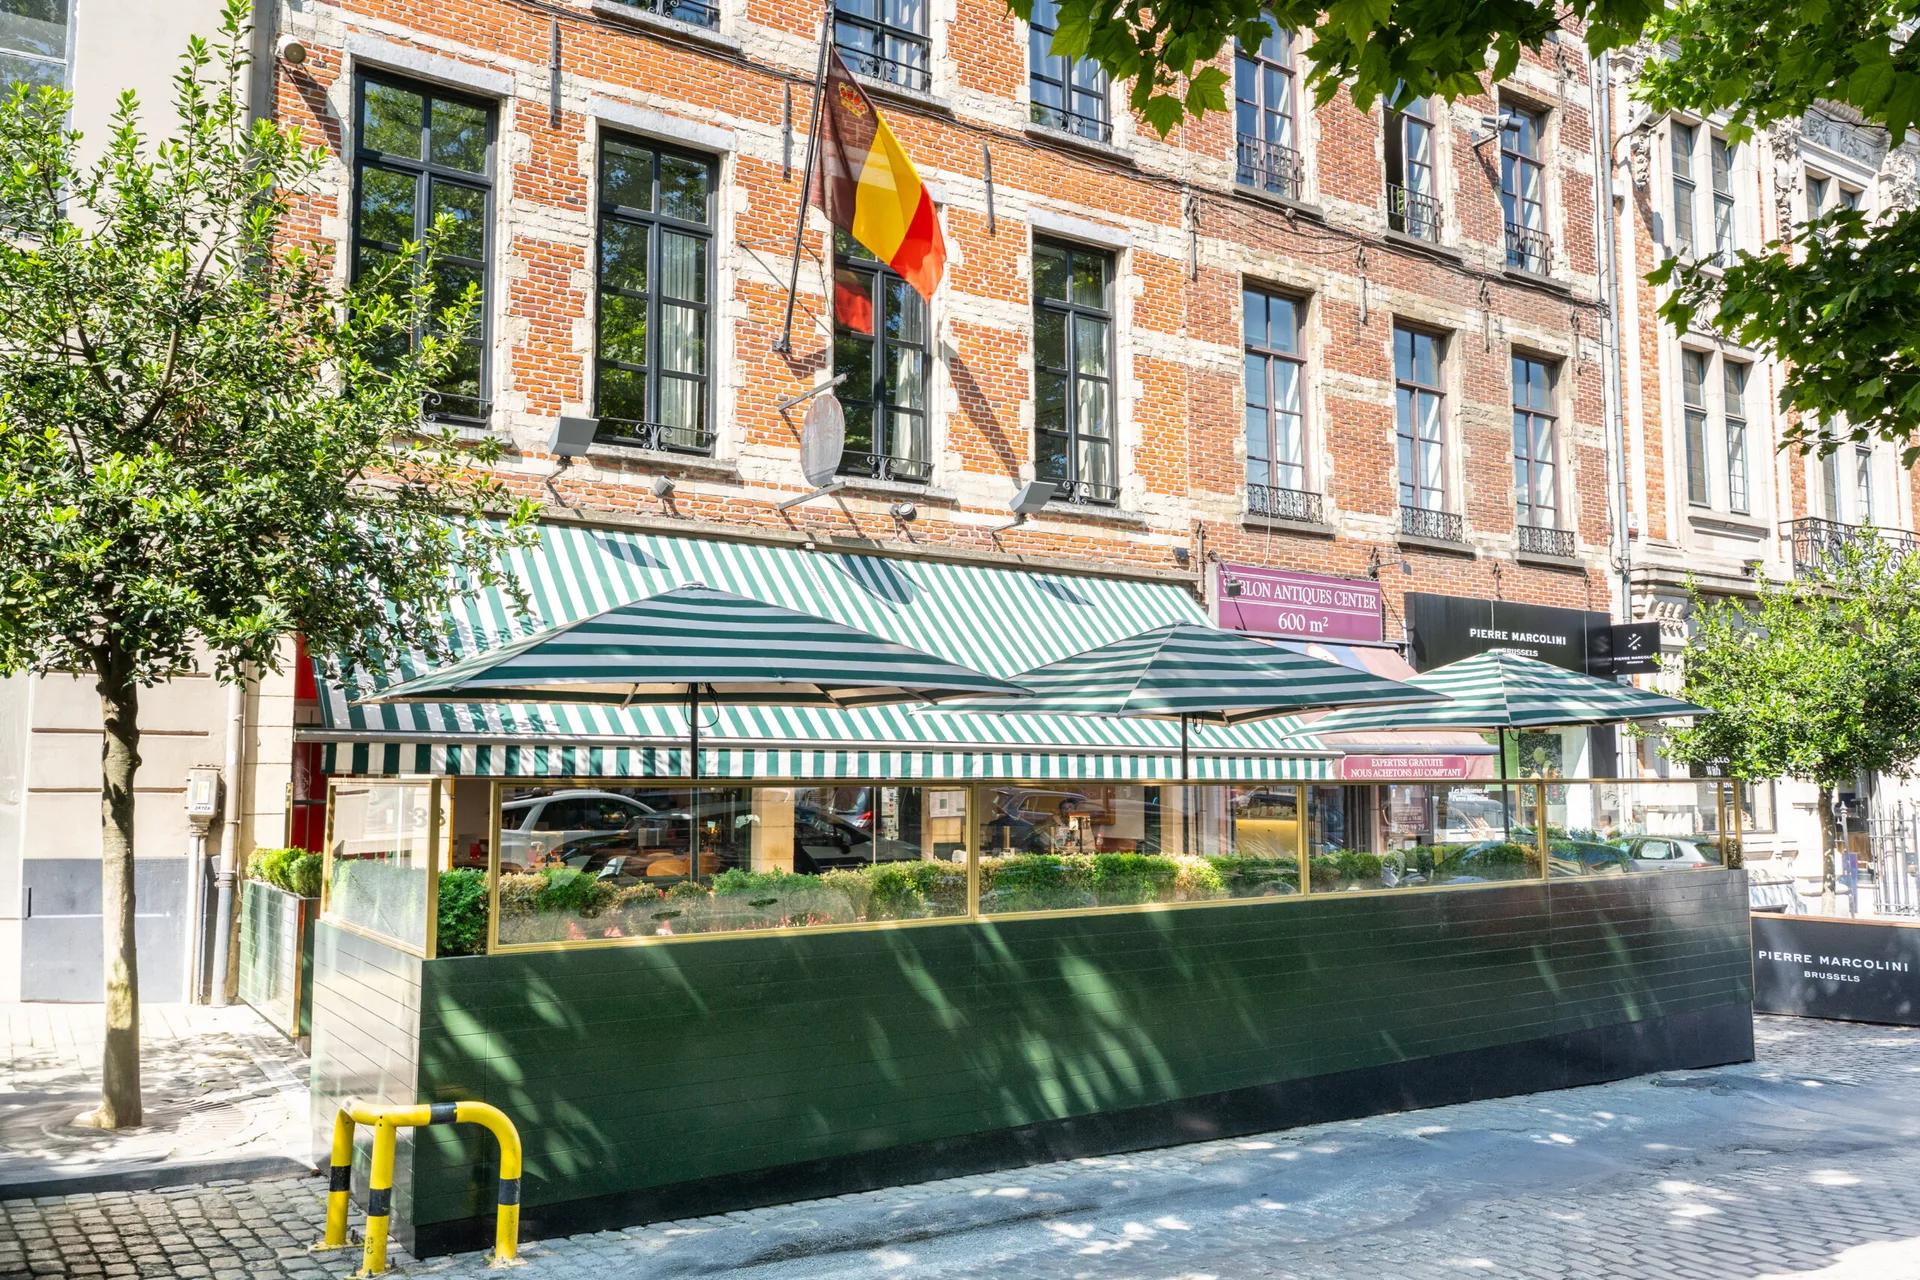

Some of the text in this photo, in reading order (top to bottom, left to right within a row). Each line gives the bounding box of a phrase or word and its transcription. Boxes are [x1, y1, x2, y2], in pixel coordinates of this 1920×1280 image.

[1223, 578, 1377, 610] SBLON ANTIQUES CENTER
[1278, 612, 1306, 631] 600
[1469, 628, 1567, 645] PIERRE MARCOLINI
[1502, 647, 1538, 657] BRUSSELS
[1371, 758, 1443, 767] EXPERTISE GRATUITE
[1350, 768, 1461, 777] NOUS ACHETONS AU COMPTANT
[1758, 950, 1909, 972] PIERRE MARCOLINI
[1804, 970, 1861, 983] BRUSSELS
